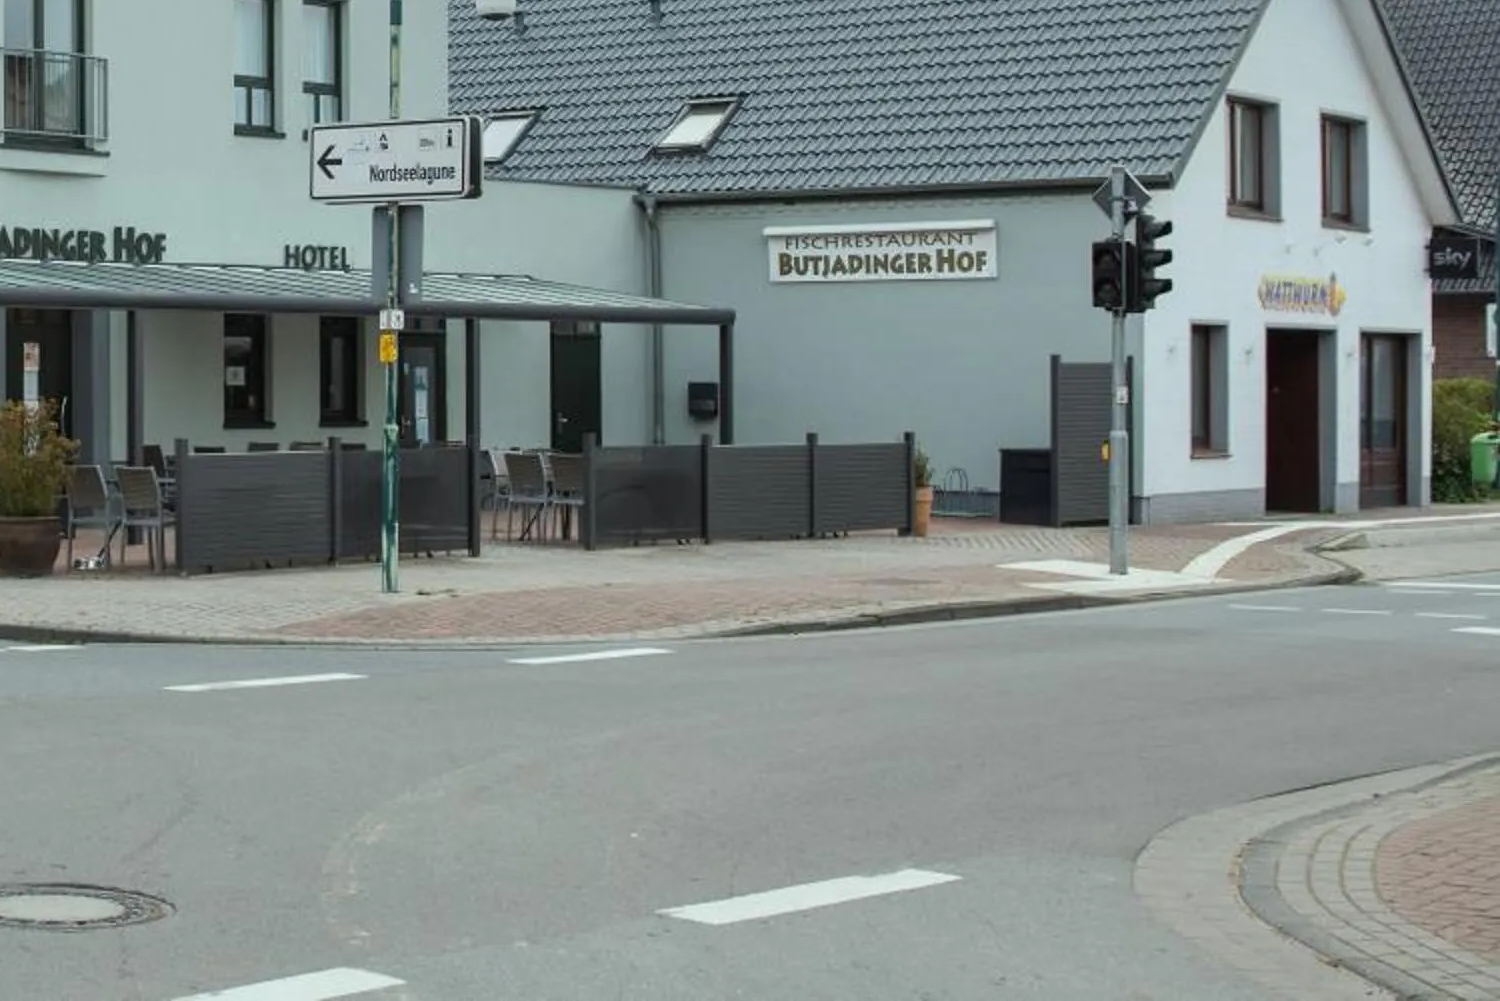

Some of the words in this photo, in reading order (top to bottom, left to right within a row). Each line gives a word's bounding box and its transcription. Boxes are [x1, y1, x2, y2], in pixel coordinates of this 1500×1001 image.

[369, 164, 455, 185] Nordseelagune
[785, 230, 977, 250] FISCHRESTAURANT
[284, 244, 350, 272] HOTEL
[1433, 247, 1472, 270] sky
